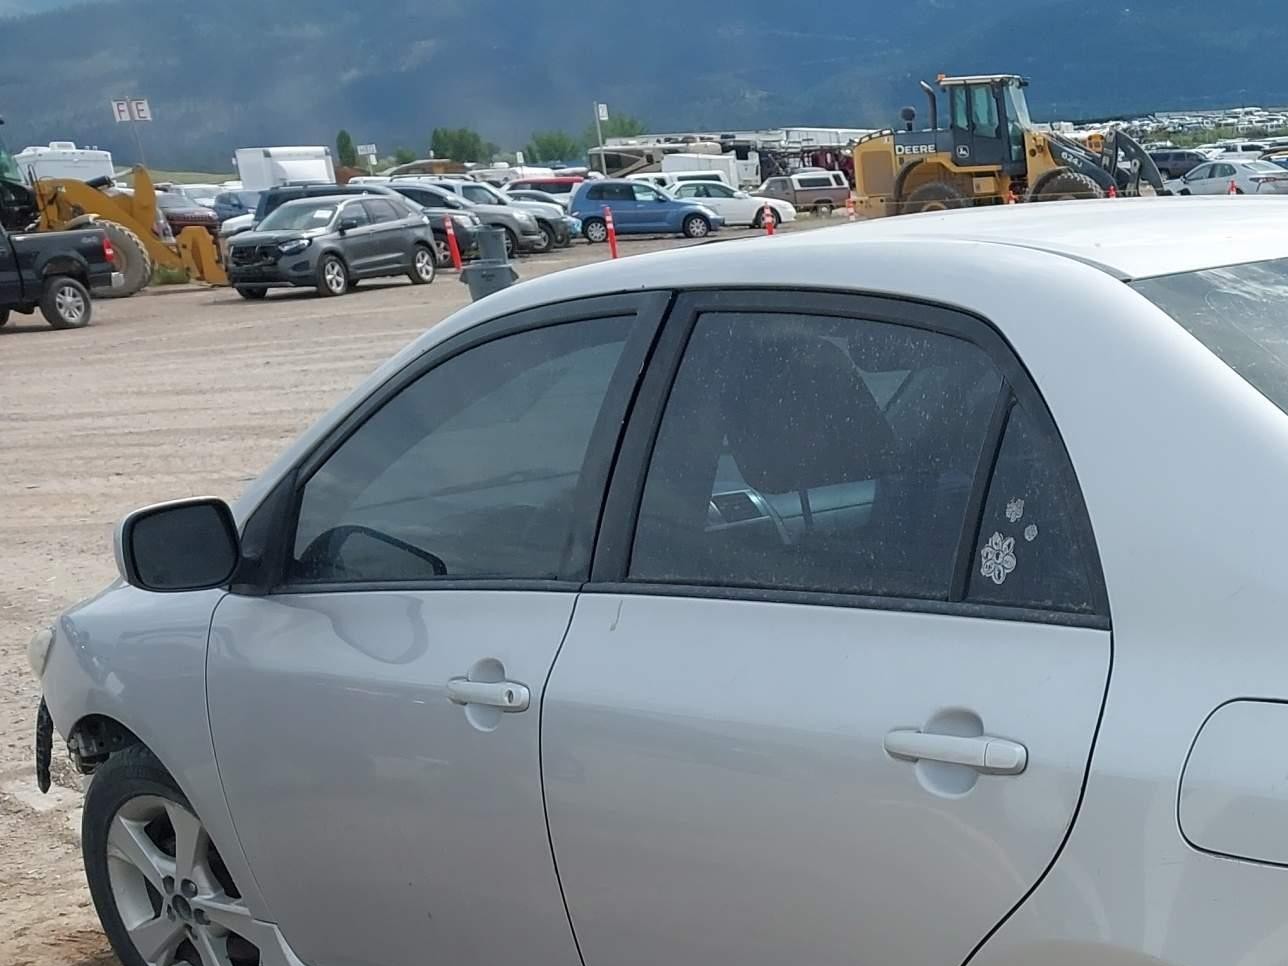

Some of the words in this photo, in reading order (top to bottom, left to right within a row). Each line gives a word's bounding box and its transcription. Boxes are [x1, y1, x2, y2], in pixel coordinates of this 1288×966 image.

[116, 102, 126, 120] F
[135, 101, 148, 119] E
[895, 144, 936, 155] DEERE
